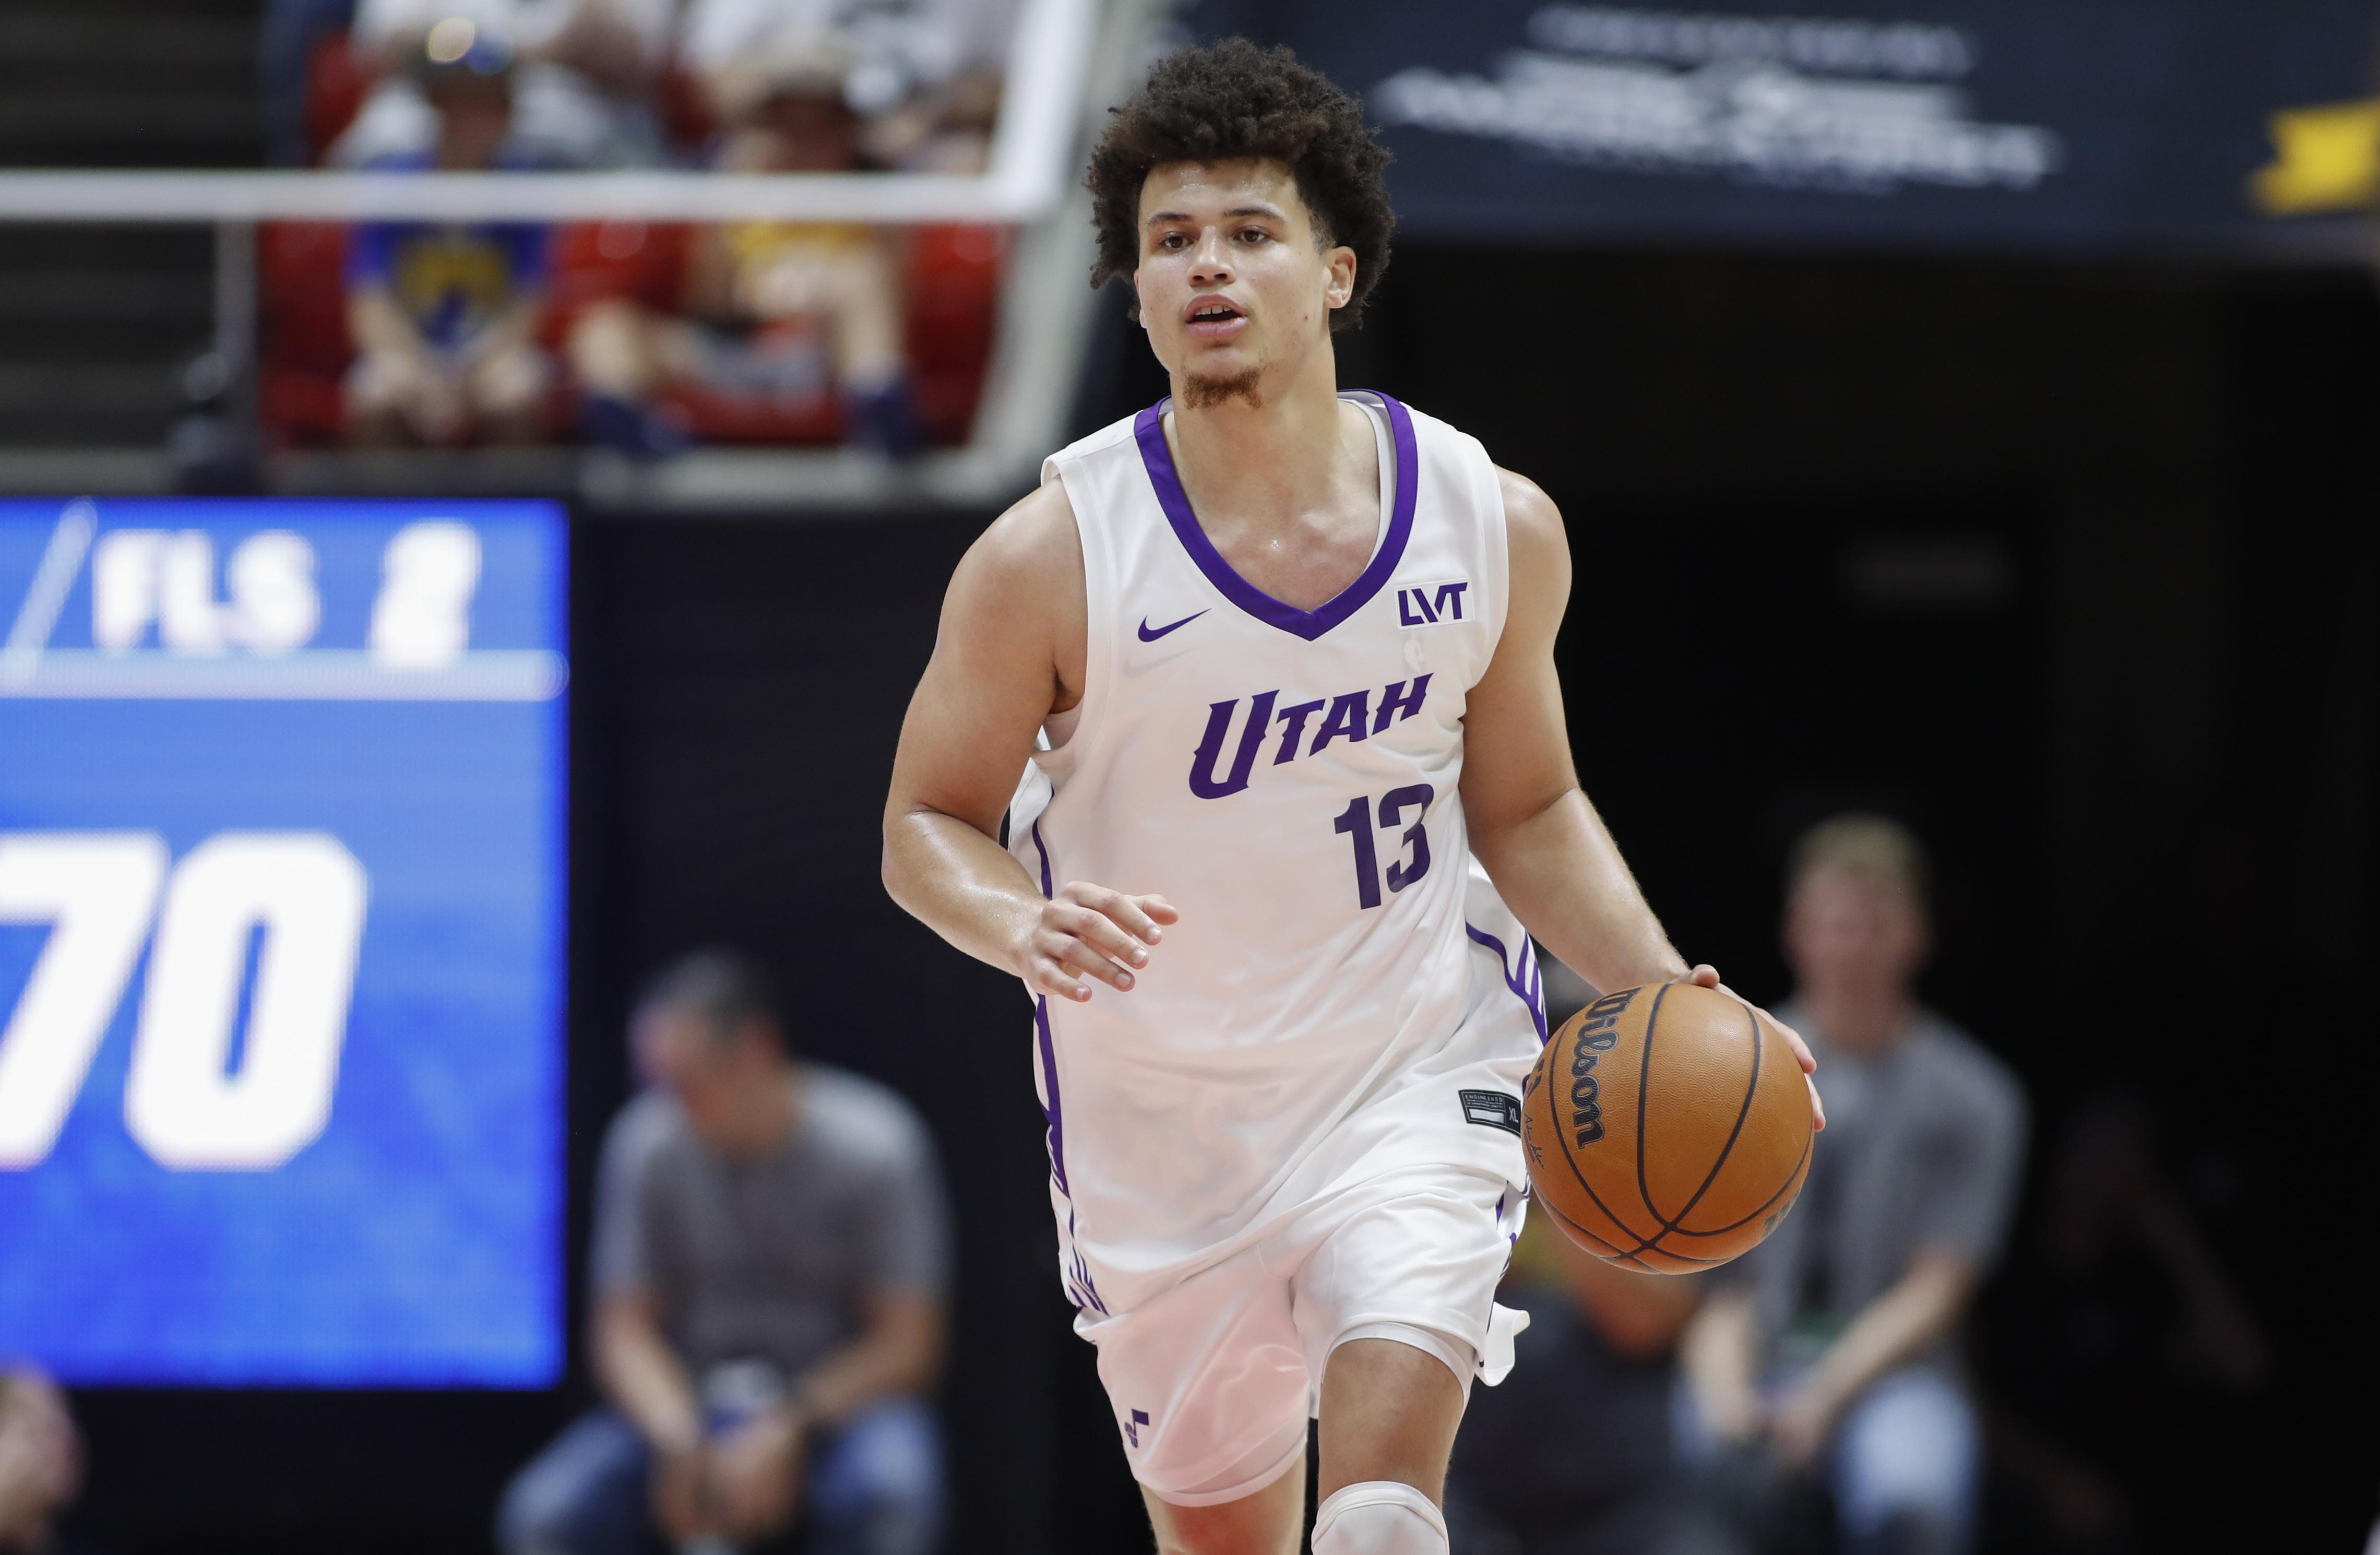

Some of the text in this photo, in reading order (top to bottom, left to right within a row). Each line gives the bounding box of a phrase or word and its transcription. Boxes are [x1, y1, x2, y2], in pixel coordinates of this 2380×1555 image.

[93, 518, 482, 670] FLS 2
[1397, 581, 1469, 626] LVT
[1188, 672, 1434, 800] UTAH
[1334, 783, 1434, 910] 13
[0, 829, 370, 1172] 70
[1508, 1106, 1519, 1123] XL
